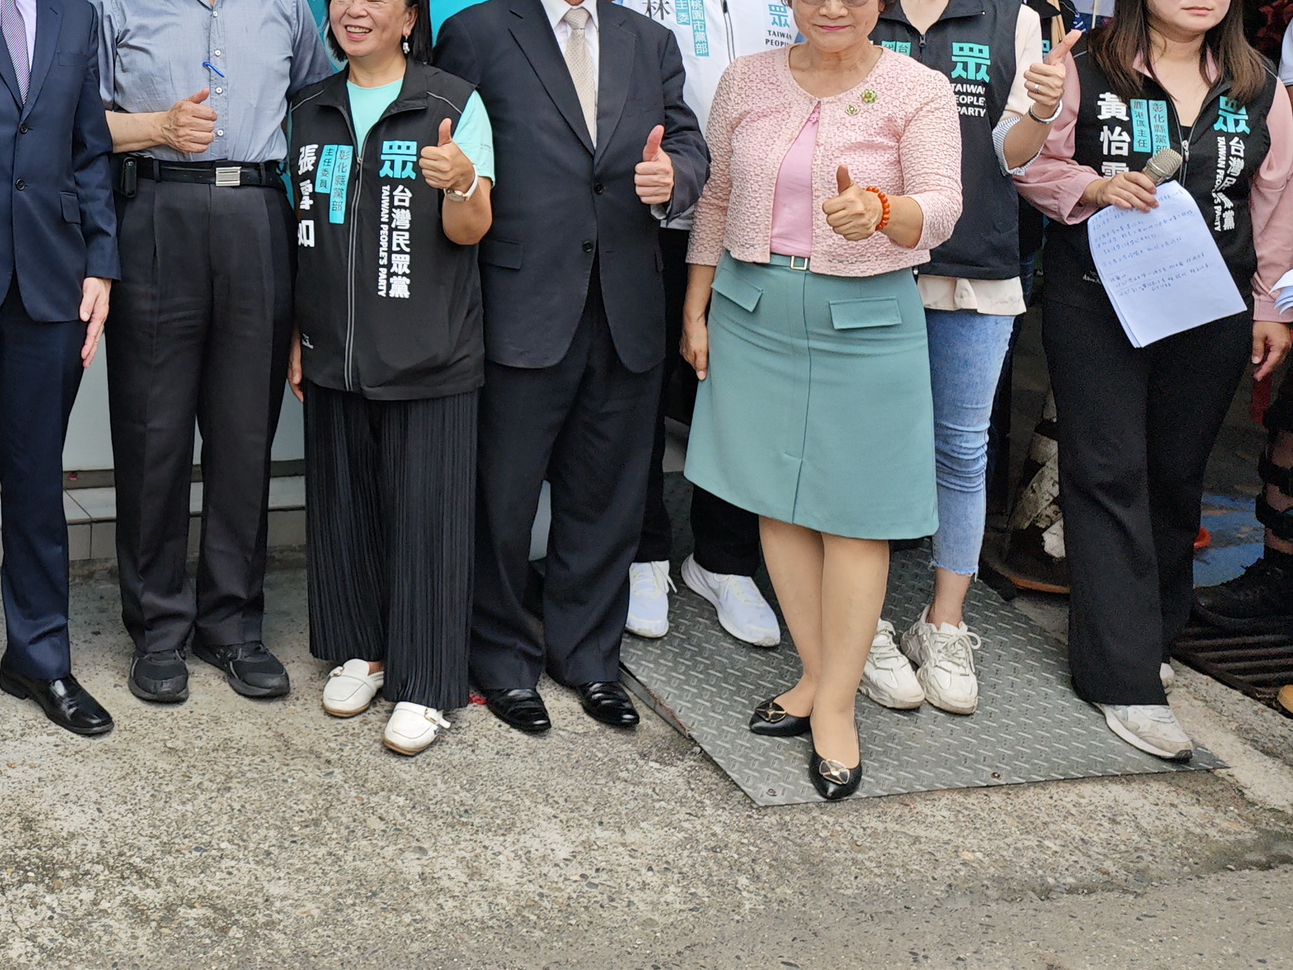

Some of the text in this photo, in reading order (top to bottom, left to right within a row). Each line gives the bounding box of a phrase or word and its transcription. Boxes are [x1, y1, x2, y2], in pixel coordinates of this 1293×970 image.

[951, 42, 991, 84] 眾
[379, 140, 418, 180] 眾
[380, 184, 391, 222] TAIWAN
[389, 184, 413, 299] 台灣民眾黨
[377, 267, 388, 298] PARTY
